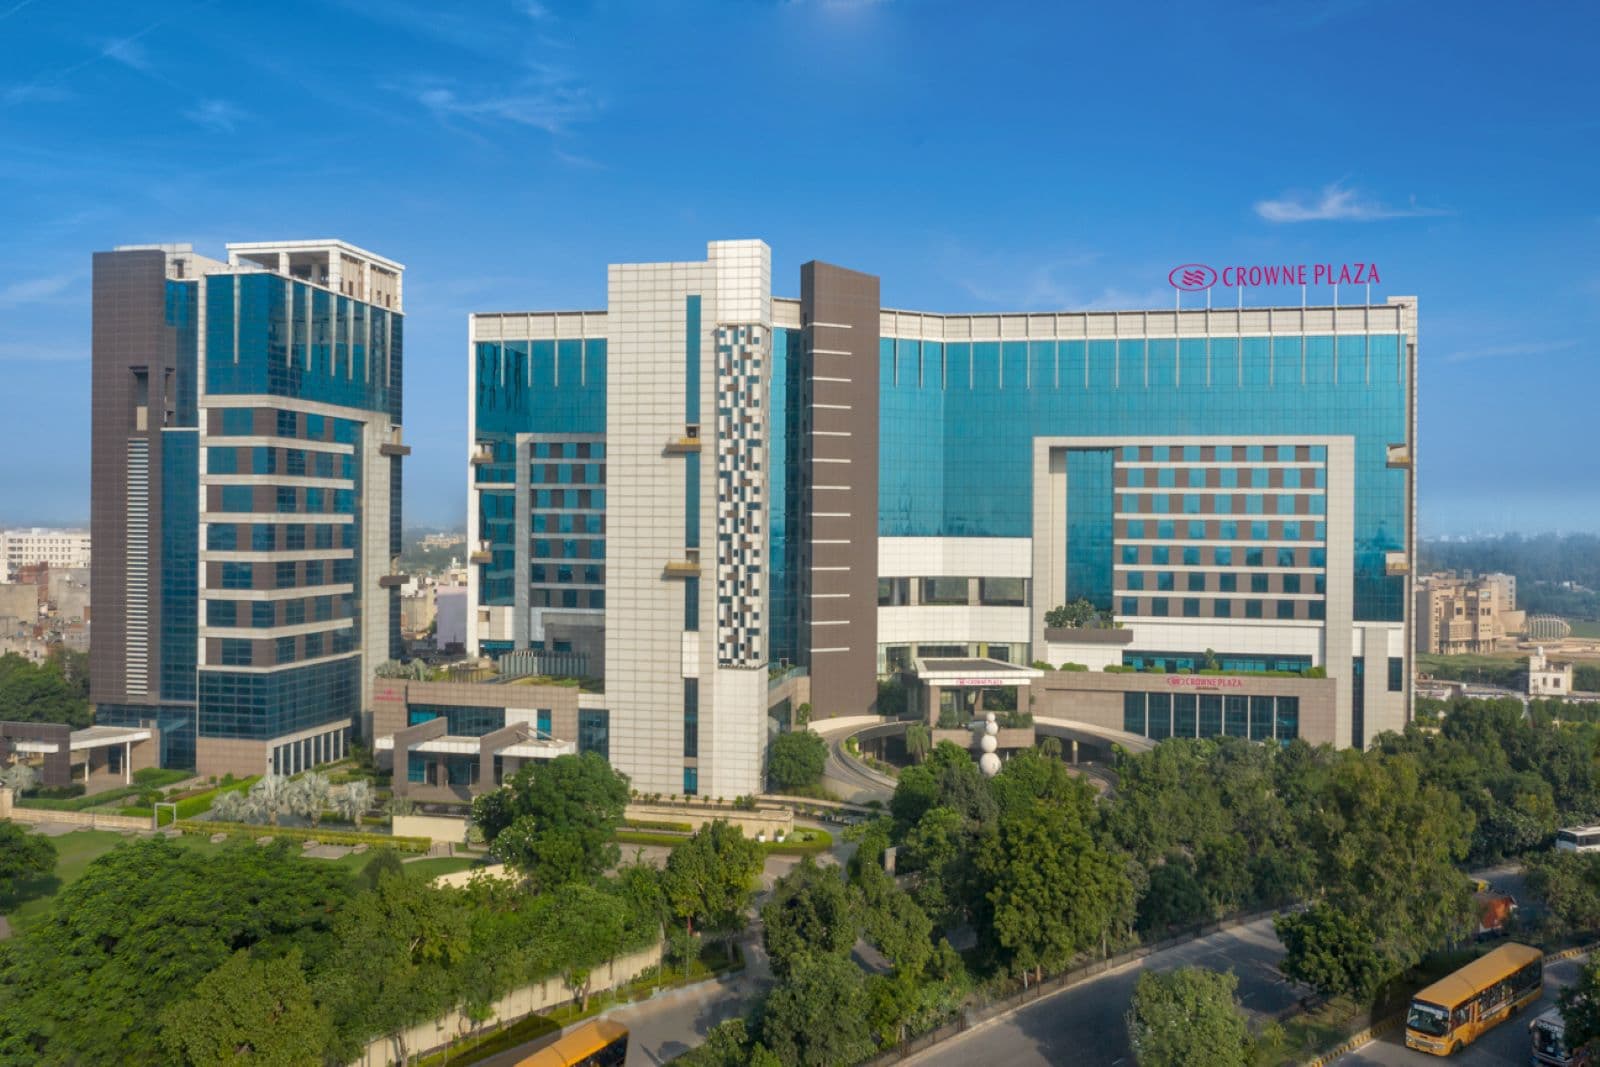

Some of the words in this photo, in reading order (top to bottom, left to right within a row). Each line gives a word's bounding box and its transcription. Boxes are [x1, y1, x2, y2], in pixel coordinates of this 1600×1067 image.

[1223, 265, 1307, 287] CROWNE
[1314, 263, 1380, 285] PLAZA
[1186, 678, 1217, 686] CROWNE
[1218, 678, 1242, 687] PLAZA
